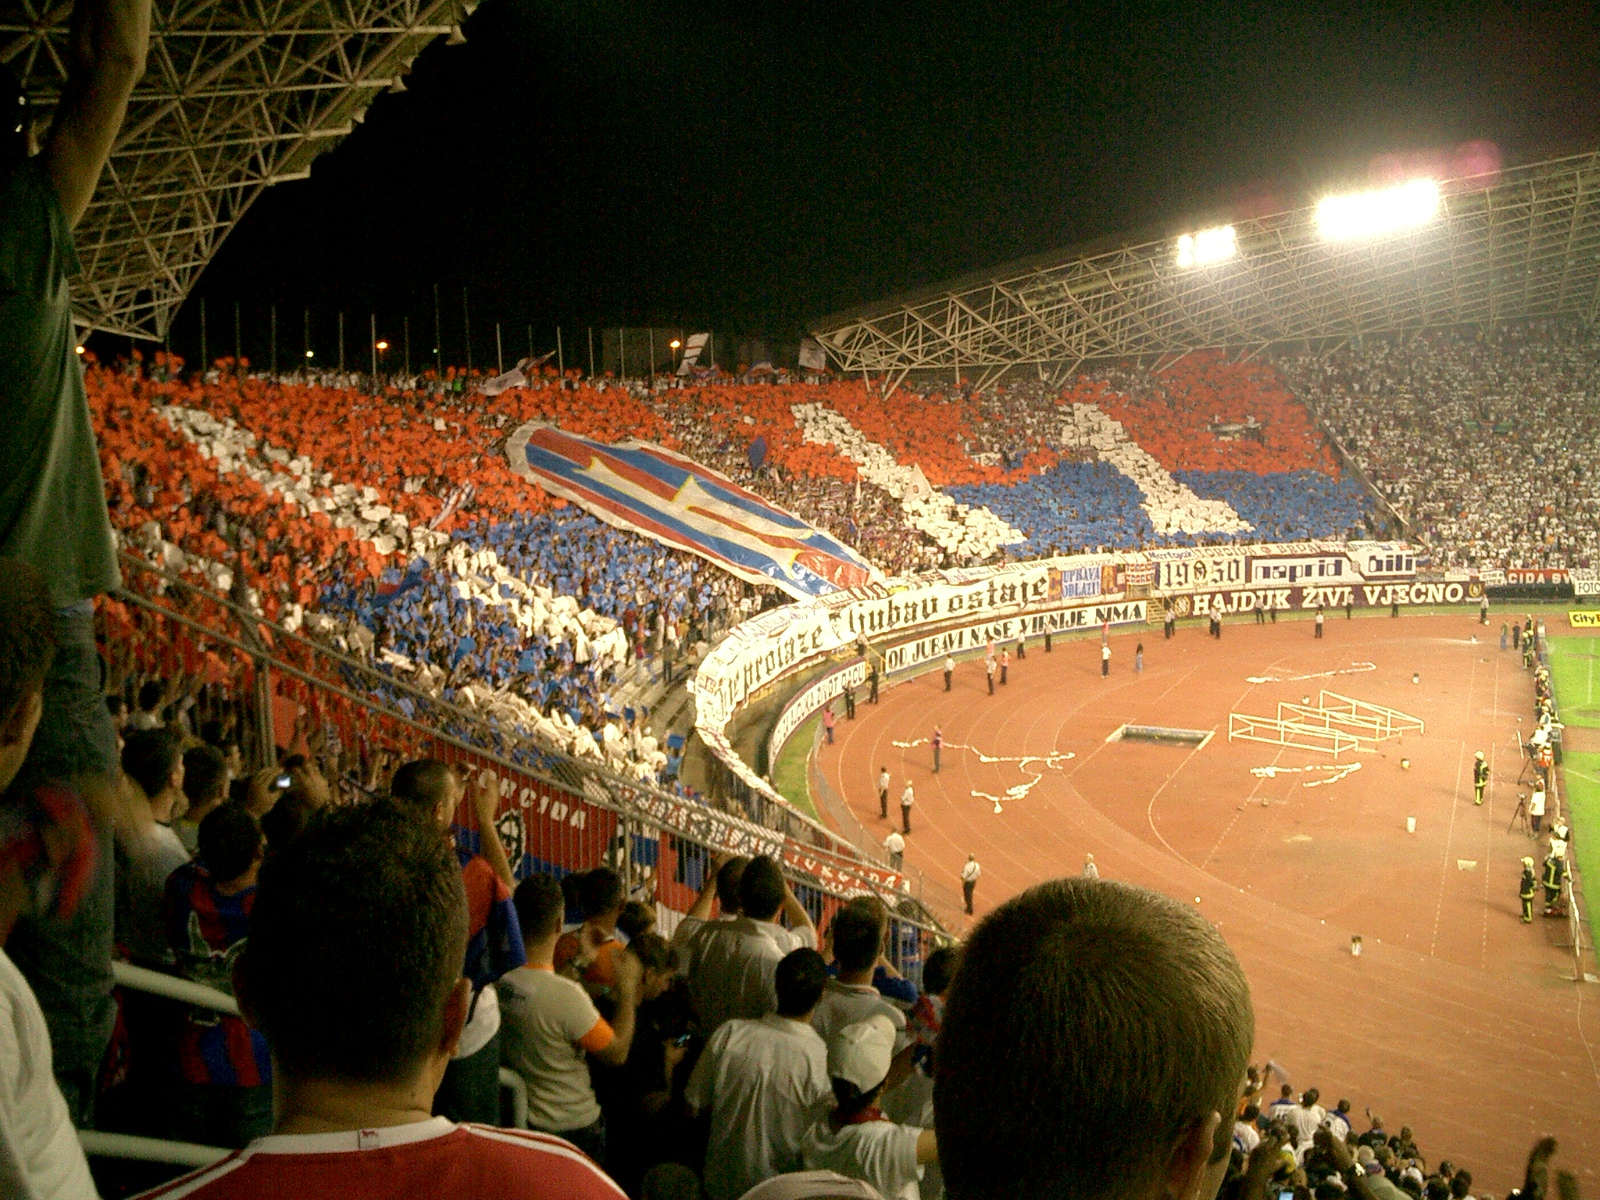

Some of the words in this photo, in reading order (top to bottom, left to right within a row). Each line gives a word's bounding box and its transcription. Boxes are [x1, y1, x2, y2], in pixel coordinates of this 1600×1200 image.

[1195, 547, 1257, 558] TORCIDA
[1063, 566, 1100, 583] UPRAVA
[848, 596, 939, 636] ljubav
[948, 573, 1048, 612] ostaje
[1193, 589, 1292, 616] HAJDUK
[1302, 585, 1353, 609] ŽIVI
[1363, 582, 1464, 605] VJEČNO
[888, 649, 908, 668] OD
[912, 630, 965, 662] JUBAVI
[1020, 609, 1088, 635] VIRNIJE
[1095, 603, 1143, 624] NIMA
